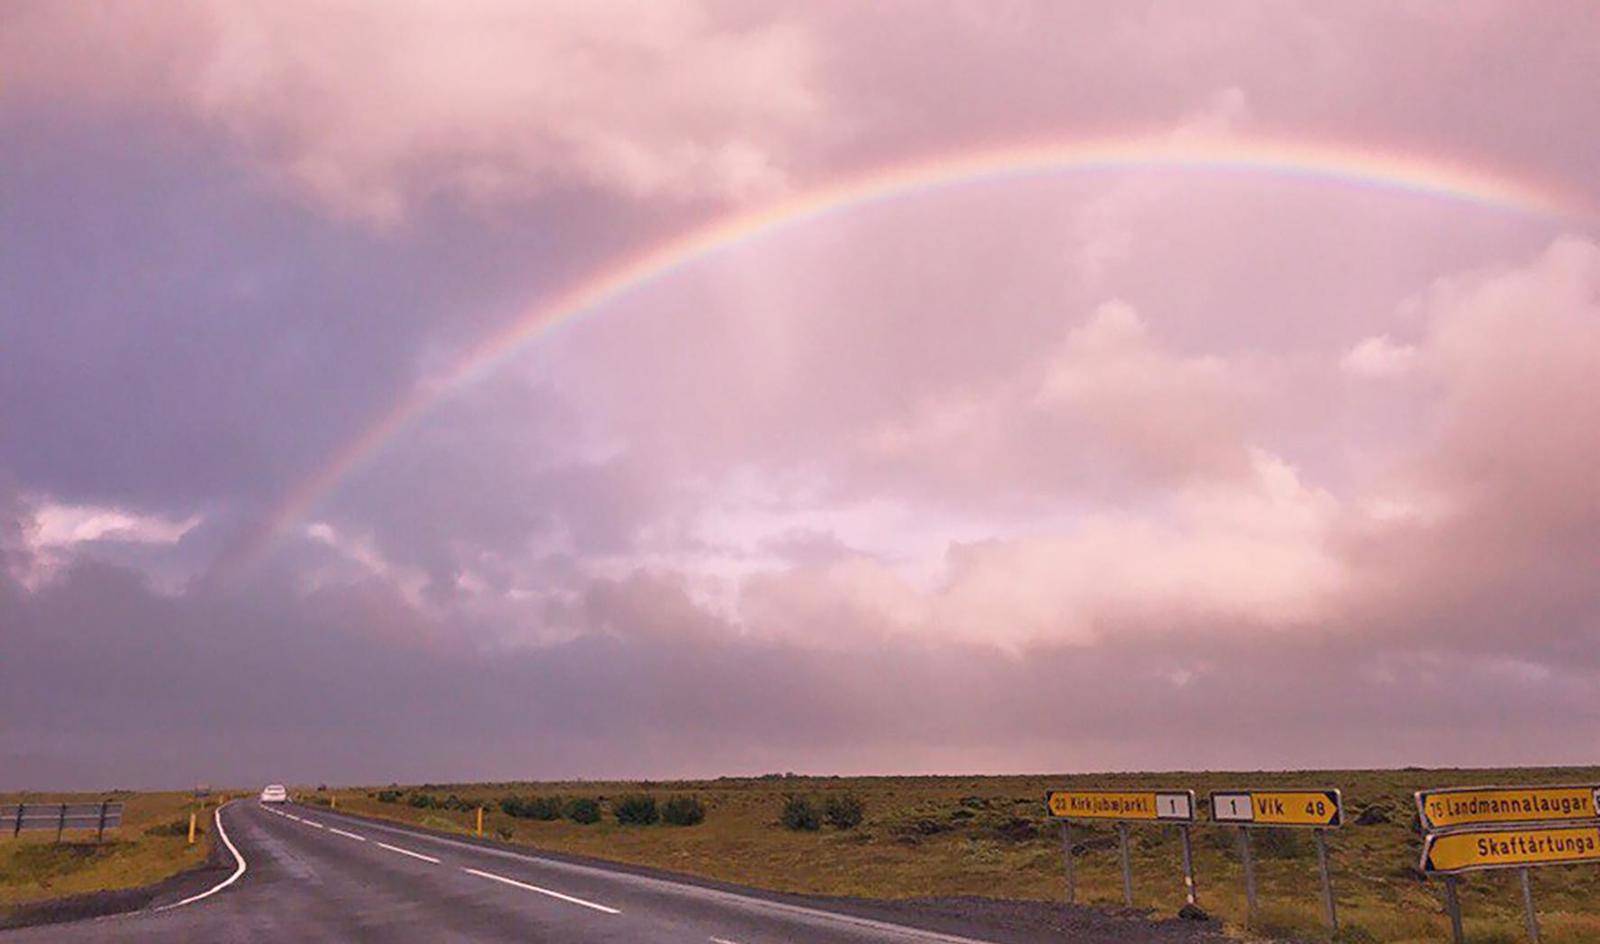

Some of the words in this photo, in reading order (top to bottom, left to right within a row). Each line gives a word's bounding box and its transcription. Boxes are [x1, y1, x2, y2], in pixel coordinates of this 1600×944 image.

[1168, 799, 1175, 813] 1
[1229, 799, 1237, 814] 1
[1304, 800, 1326, 816] 48
[1447, 795, 1588, 817] Landmannalaugar
[1477, 836, 1594, 858] Skaftártunga
